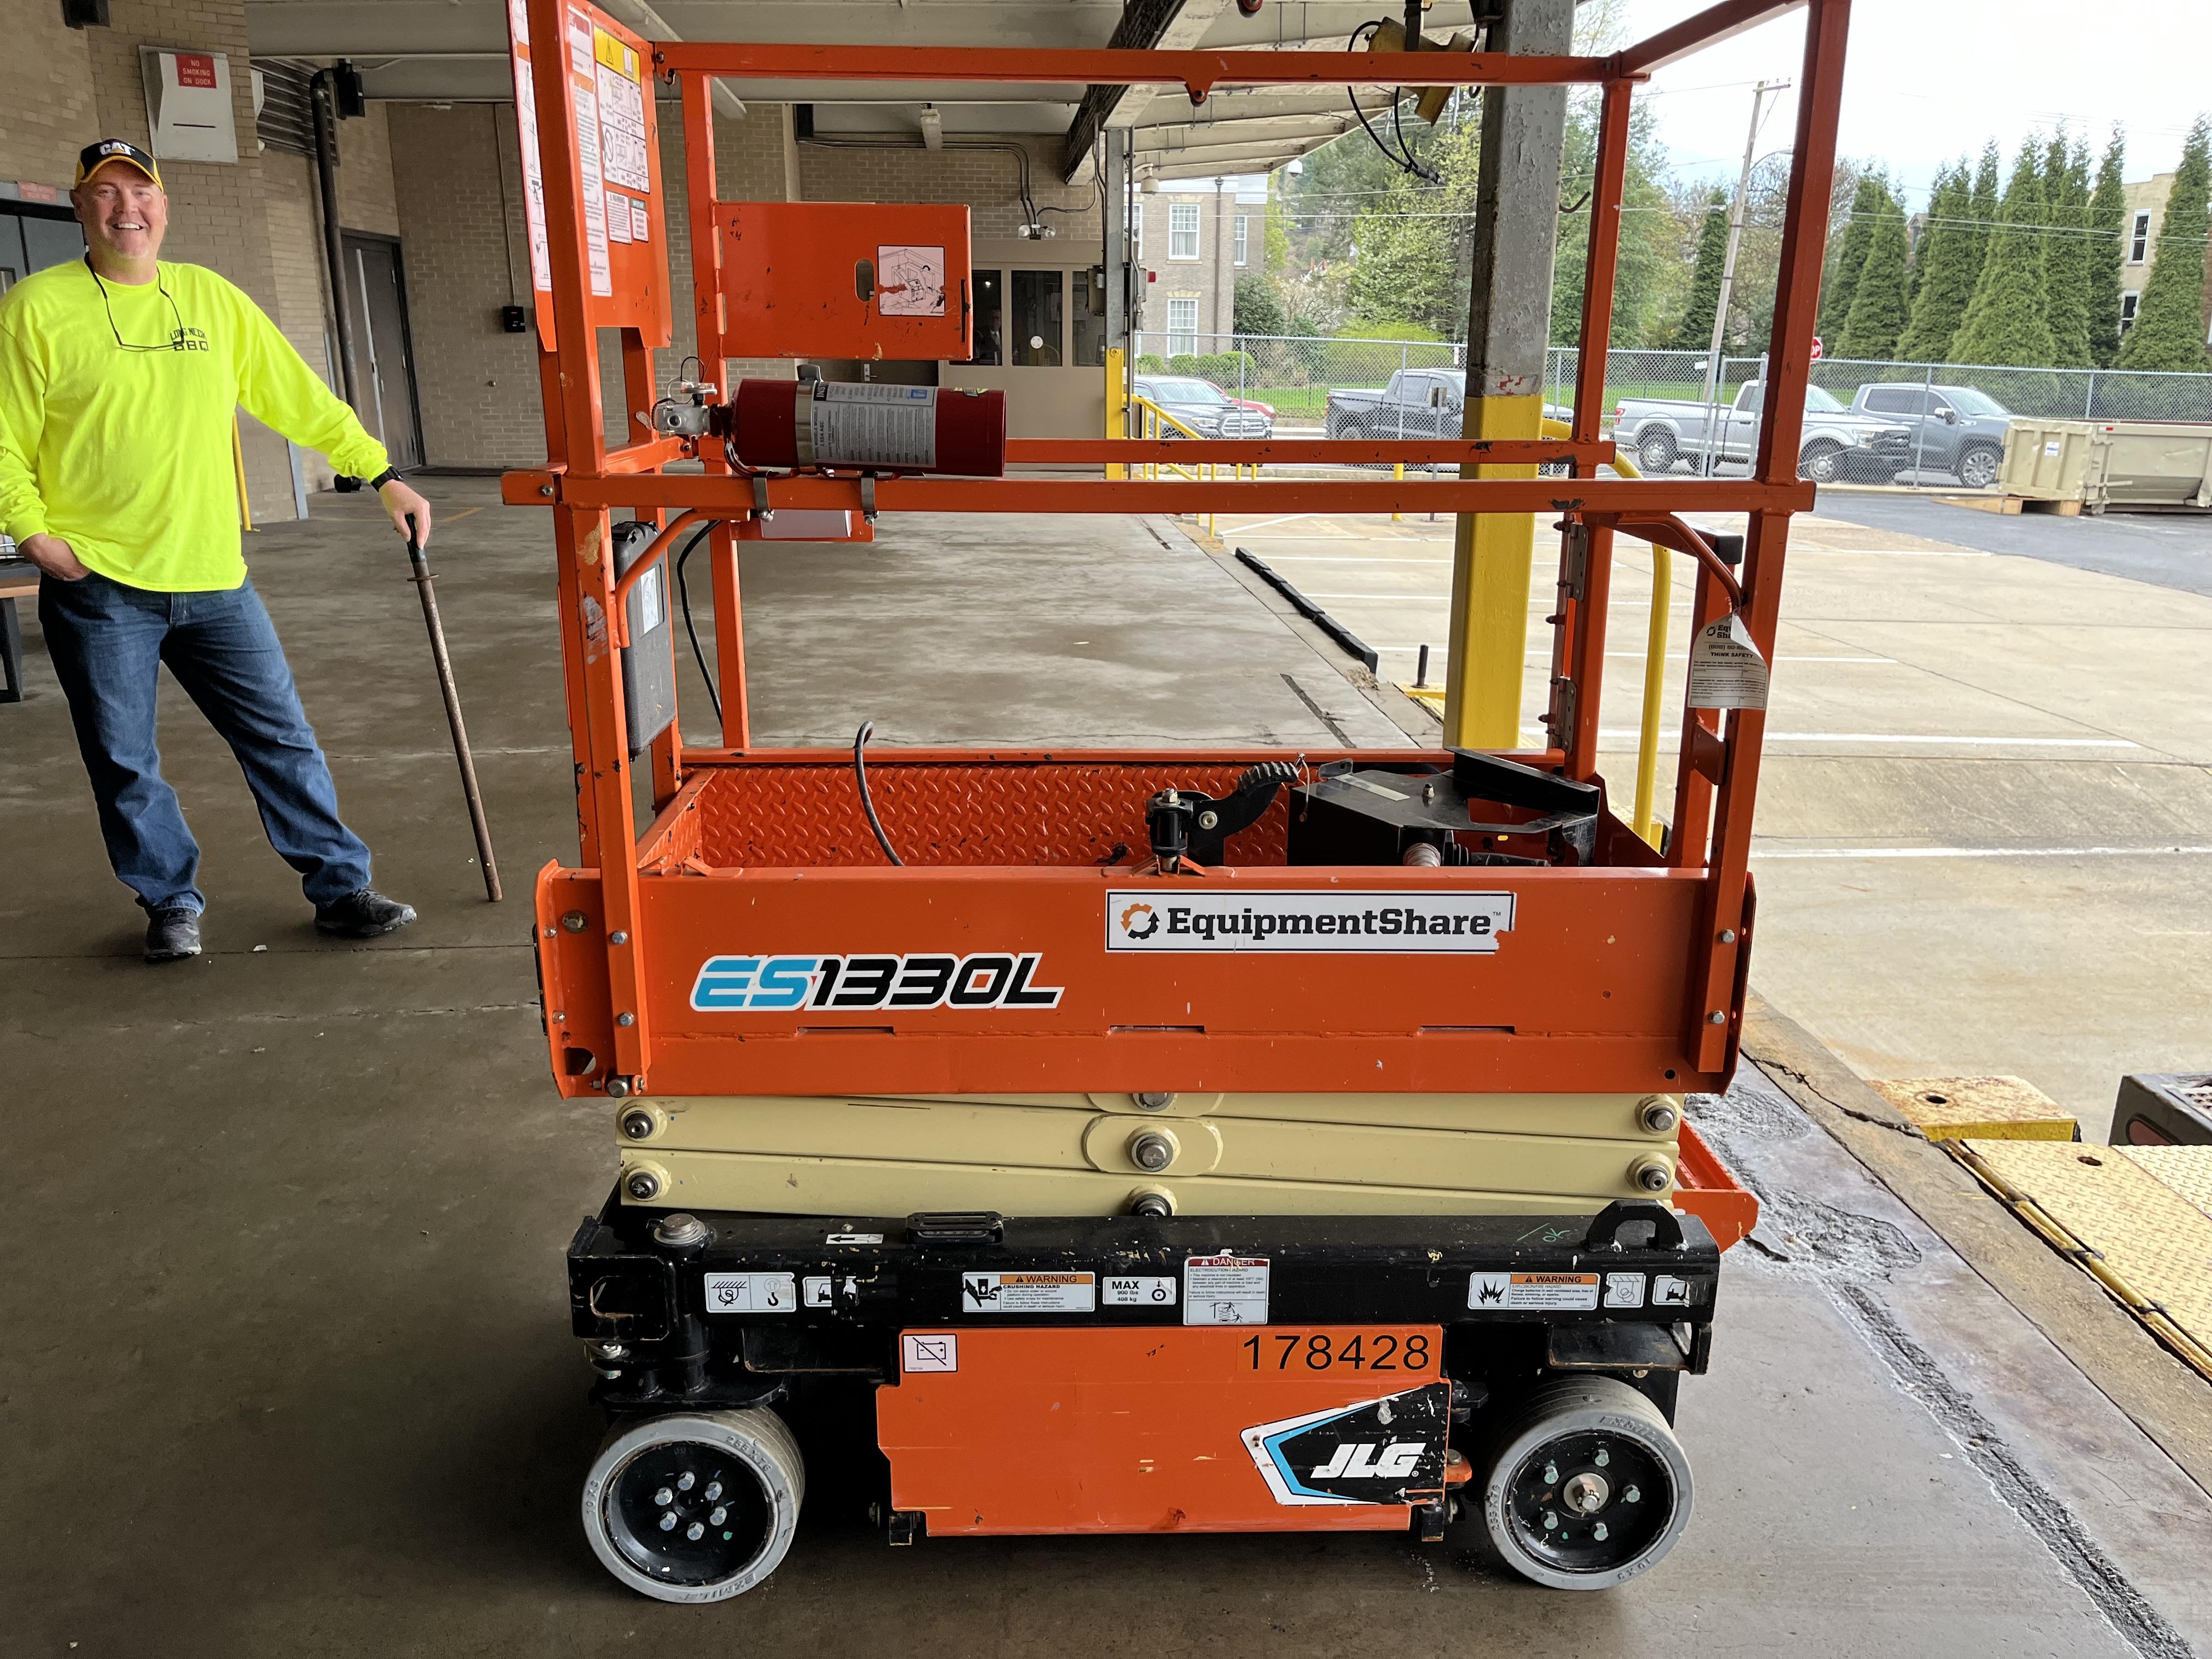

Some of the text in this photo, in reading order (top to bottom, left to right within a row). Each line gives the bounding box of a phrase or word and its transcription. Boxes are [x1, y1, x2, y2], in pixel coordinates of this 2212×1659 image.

[182, 67, 211, 76] SMOKING
[99, 142, 132, 156] CAT
[1167, 907, 1491, 940] EquipmentShare
[693, 956, 1060, 1009] ES1330L
[1111, 1280, 1139, 1289] MAX
[1243, 1335, 1429, 1370] 178428
[1311, 1442, 1426, 1479] JLG
